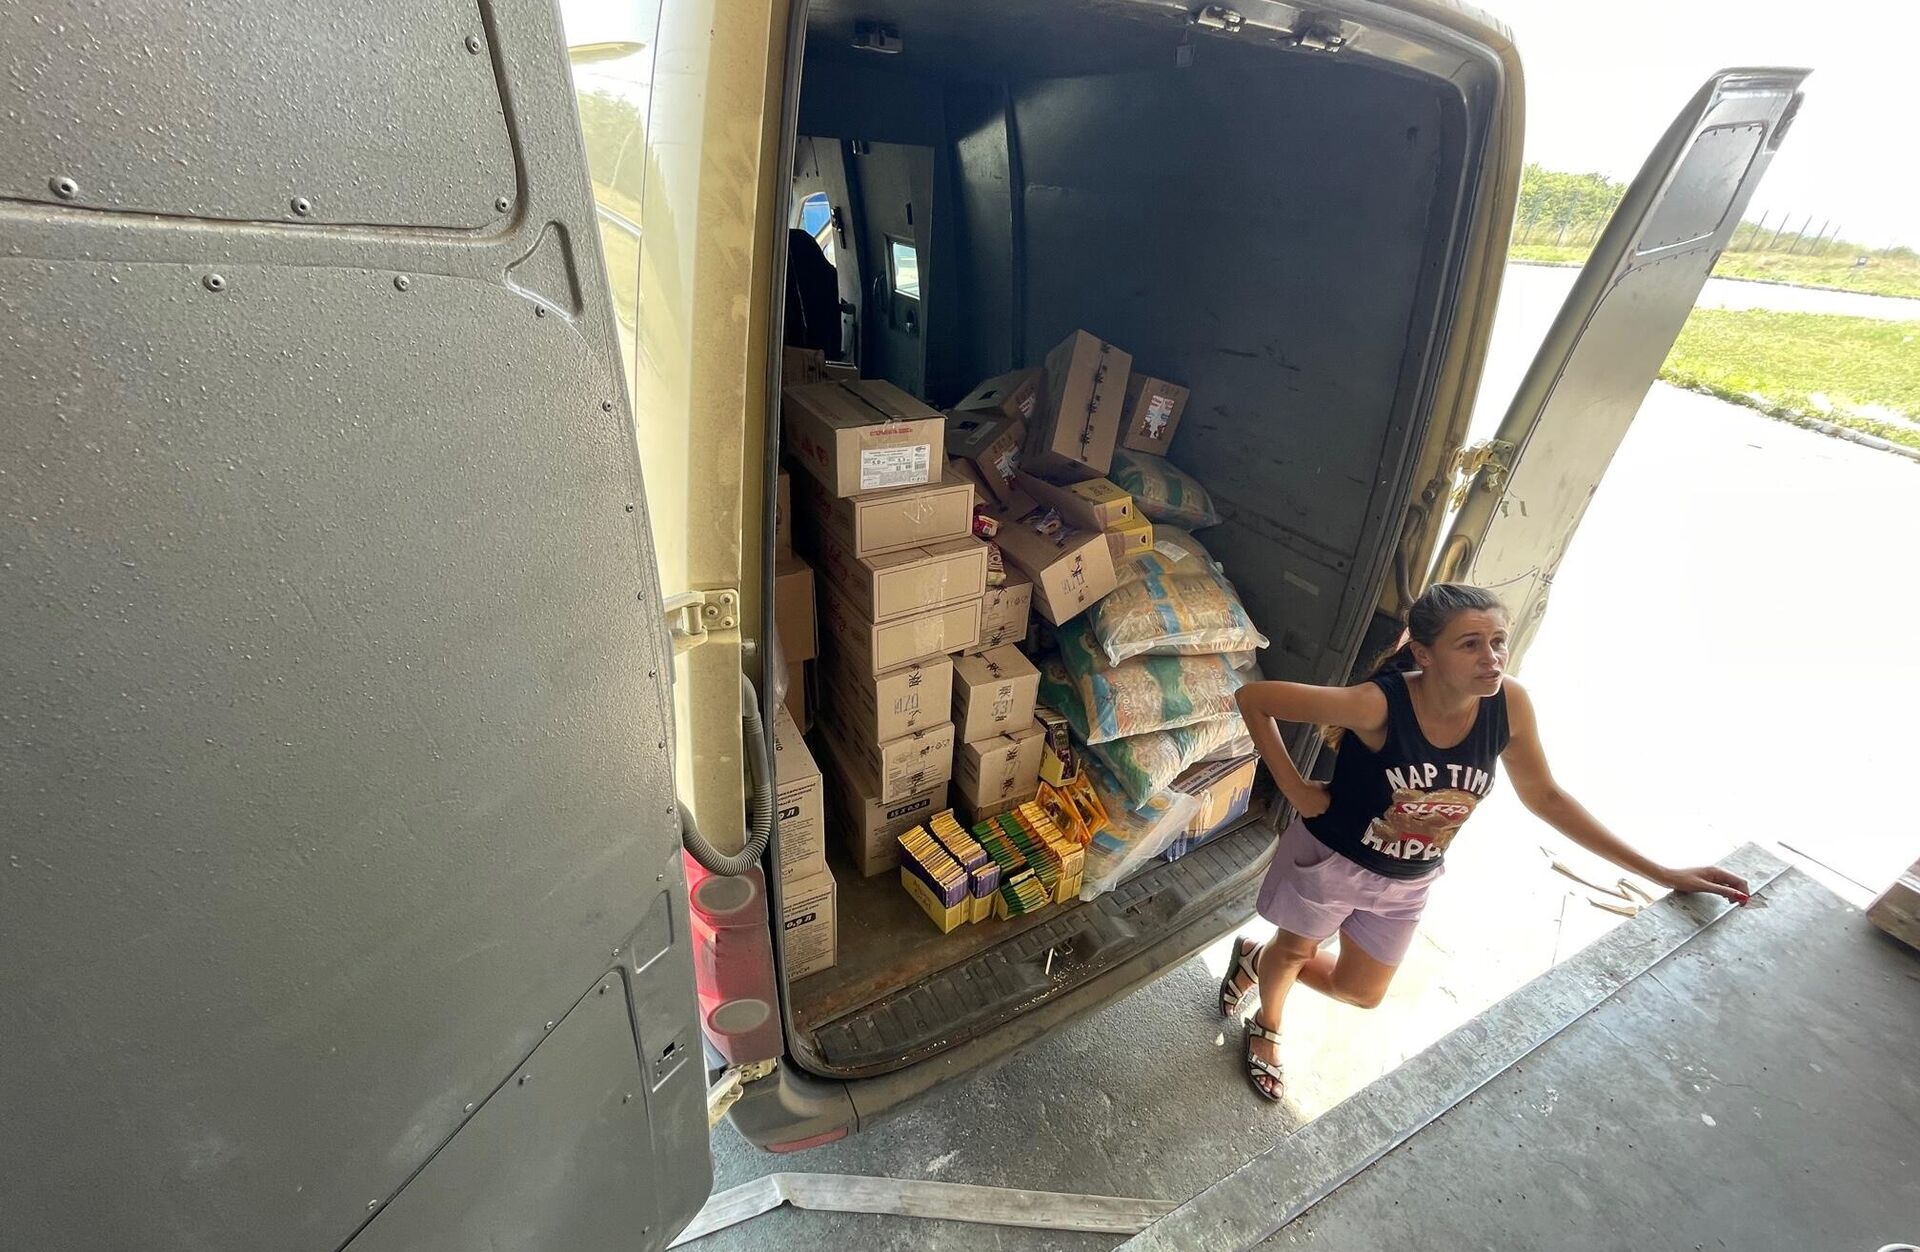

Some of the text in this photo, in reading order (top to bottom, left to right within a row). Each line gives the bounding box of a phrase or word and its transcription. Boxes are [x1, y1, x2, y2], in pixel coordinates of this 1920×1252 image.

[1385, 762, 1496, 797] NAP TIM
[1361, 816, 1441, 860] HAPP
